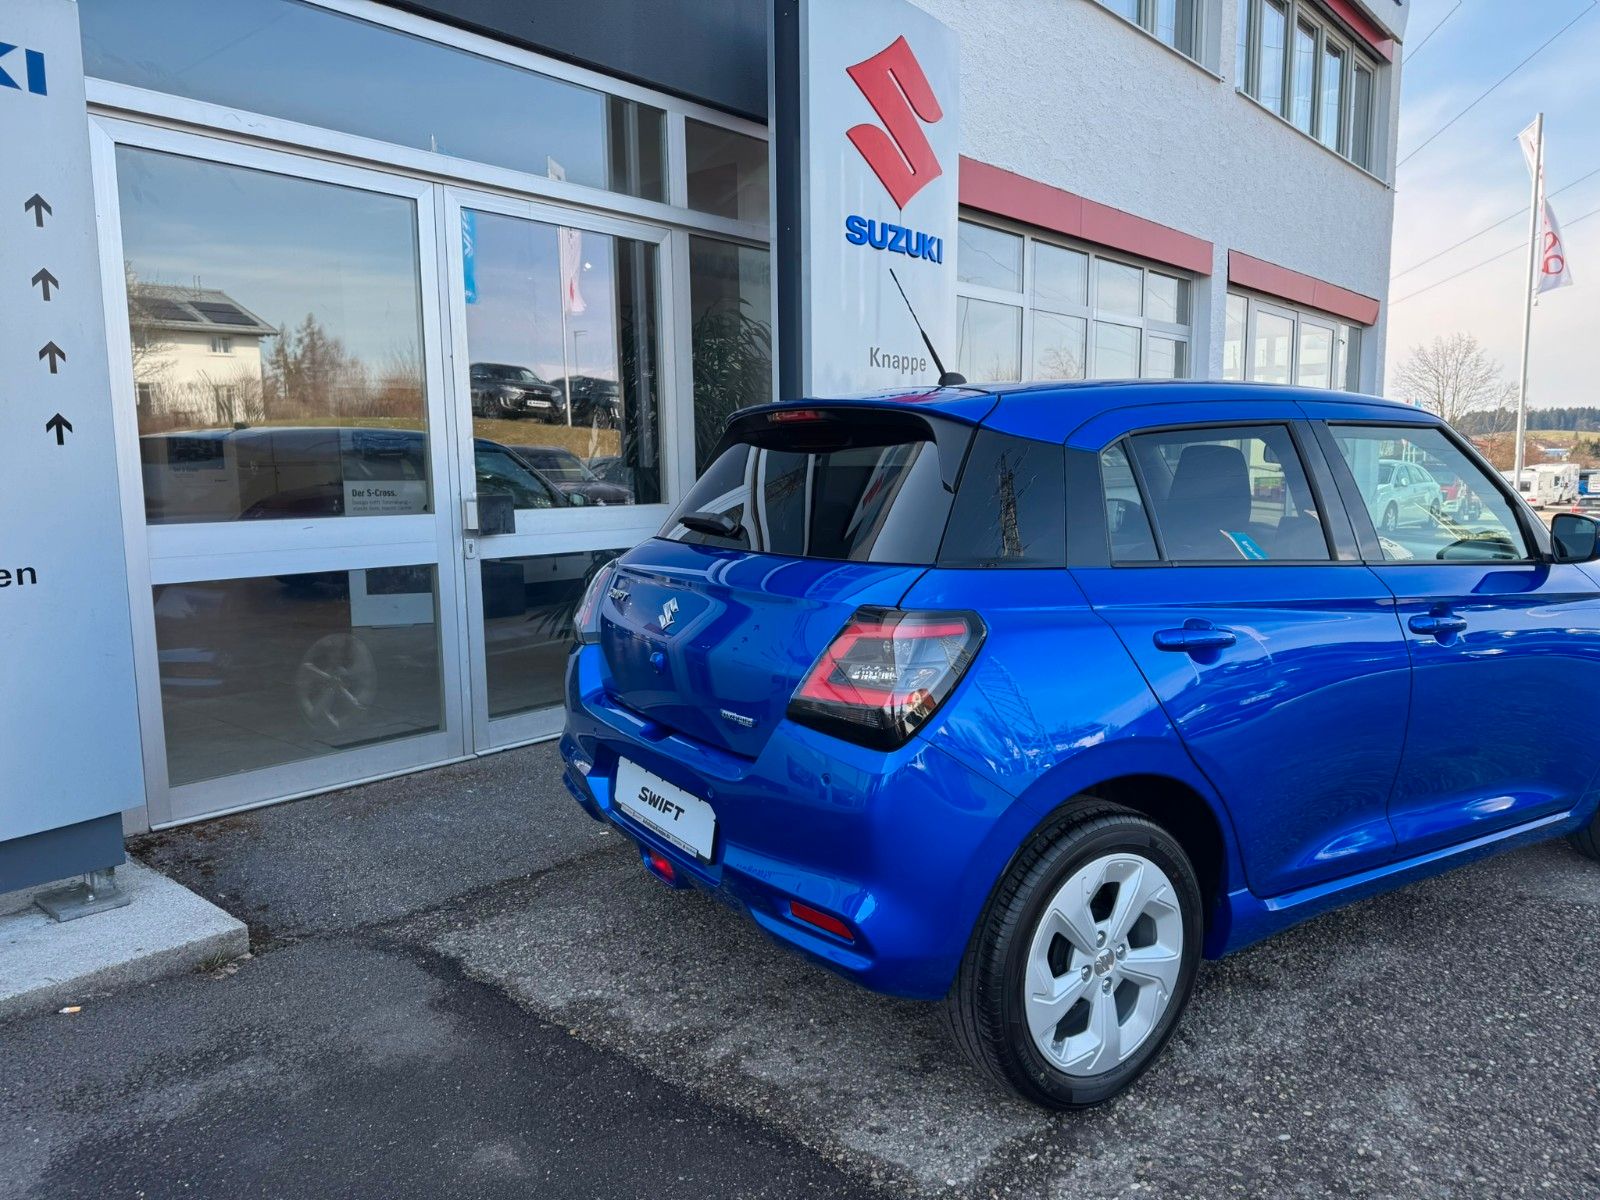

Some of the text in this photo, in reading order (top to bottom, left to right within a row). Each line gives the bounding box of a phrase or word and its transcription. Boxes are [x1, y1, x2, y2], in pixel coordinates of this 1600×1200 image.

[845, 214, 943, 264] SUZUKI
[869, 346, 927, 375] Knappe
[351, 488, 398, 497] Der S-Cross.
[0, 567, 37, 588] en
[638, 786, 685, 821] SWIFT
